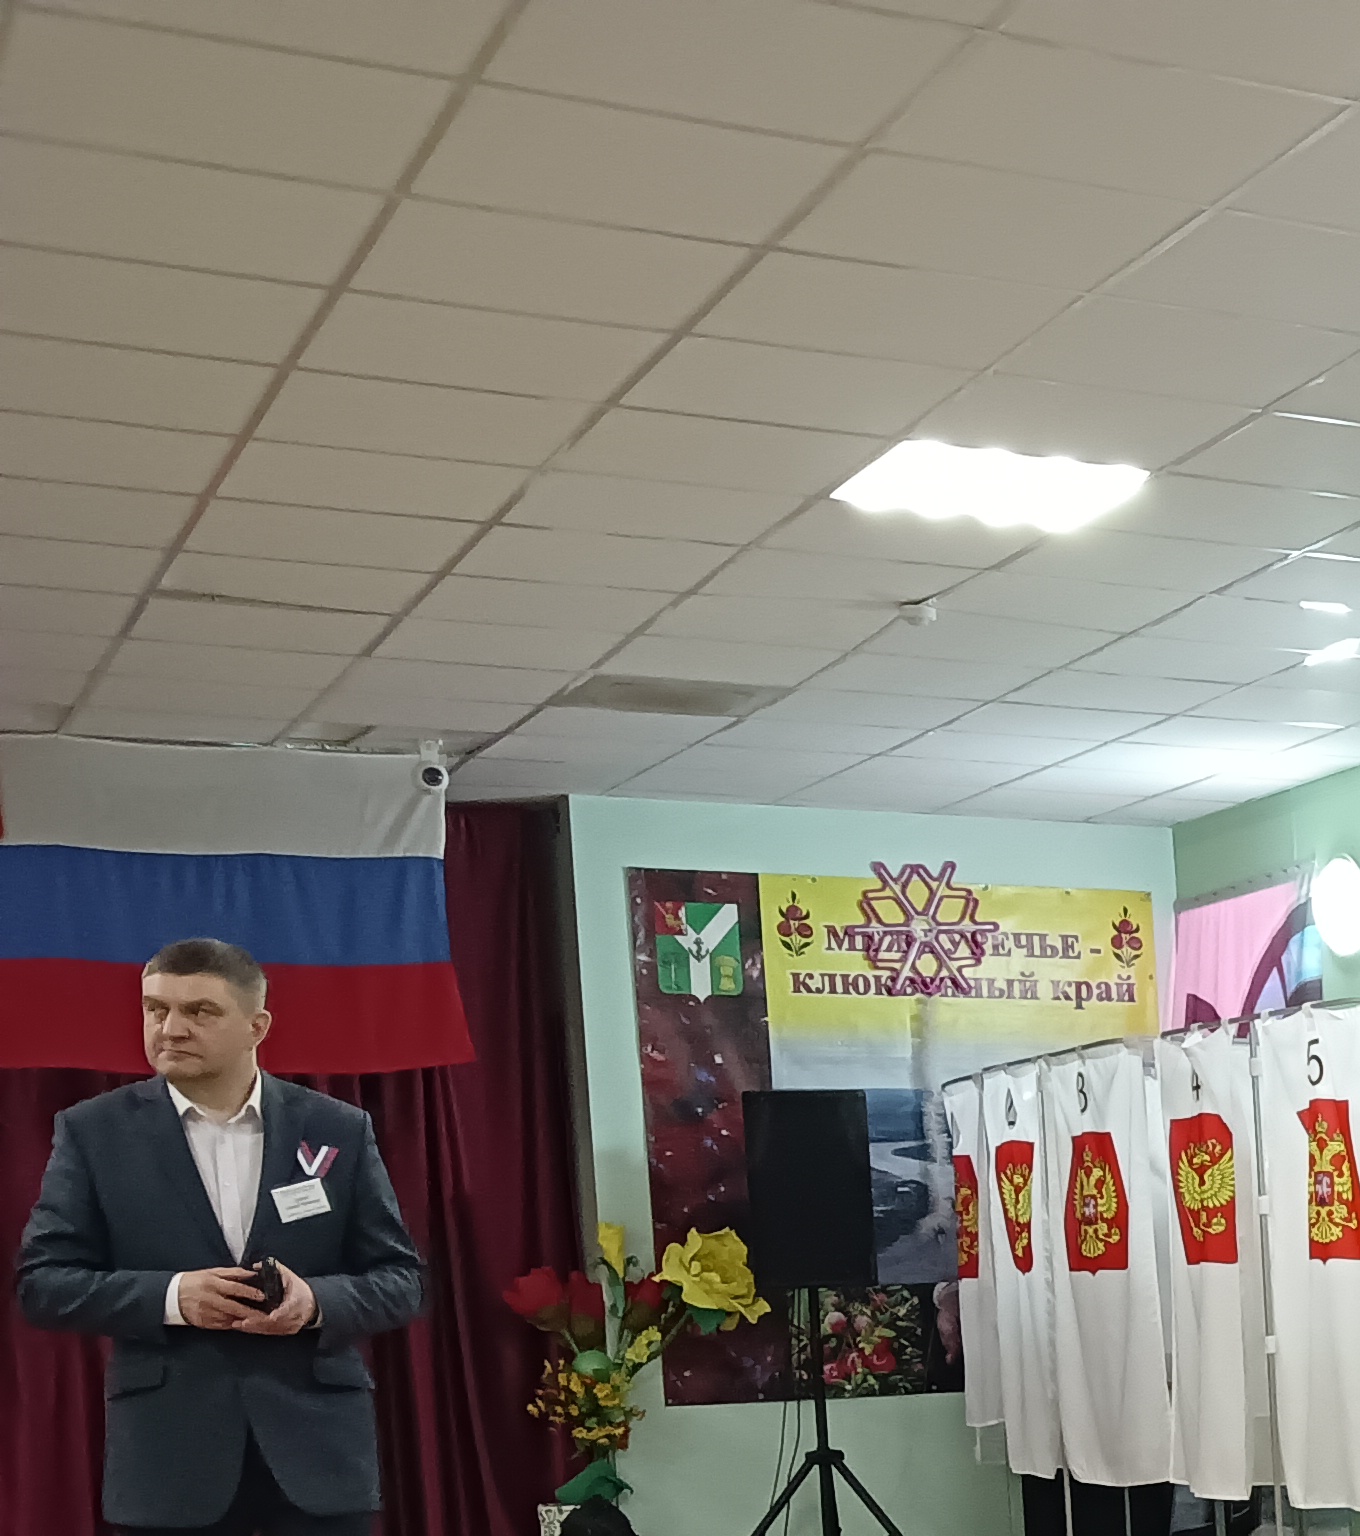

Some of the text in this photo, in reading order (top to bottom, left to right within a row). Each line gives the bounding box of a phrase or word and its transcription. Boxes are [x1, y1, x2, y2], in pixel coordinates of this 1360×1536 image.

[1051, 973, 1136, 1010] край
[1306, 1038, 1324, 1086] 5
[1076, 1071, 1088, 1114] 3
